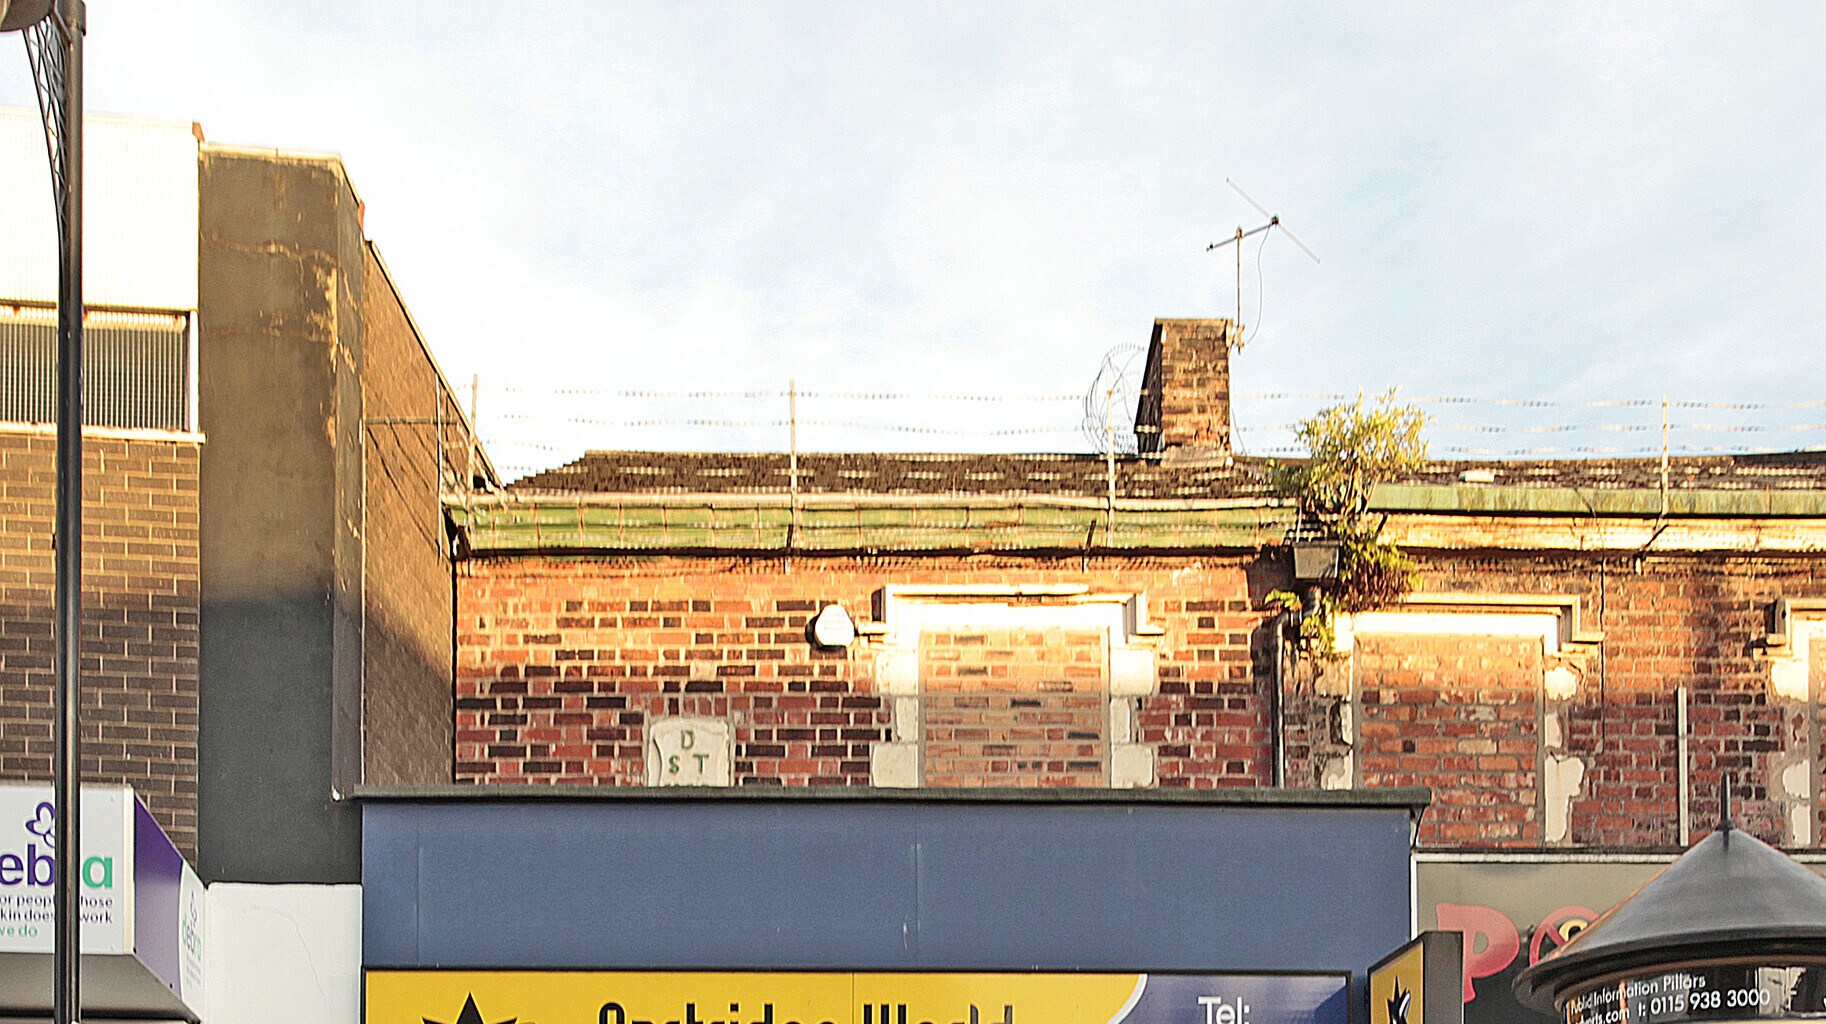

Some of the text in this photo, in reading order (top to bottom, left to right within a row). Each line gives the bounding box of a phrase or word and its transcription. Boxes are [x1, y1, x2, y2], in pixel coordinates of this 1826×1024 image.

[681, 729, 695, 749] D
[669, 753, 709, 774] S T
[1663, 973, 1706, 992] Pillars
[1650, 995, 1685, 1015] 0115
[1689, 990, 1721, 1010] 938
[1727, 988, 1770, 1008] 3000
